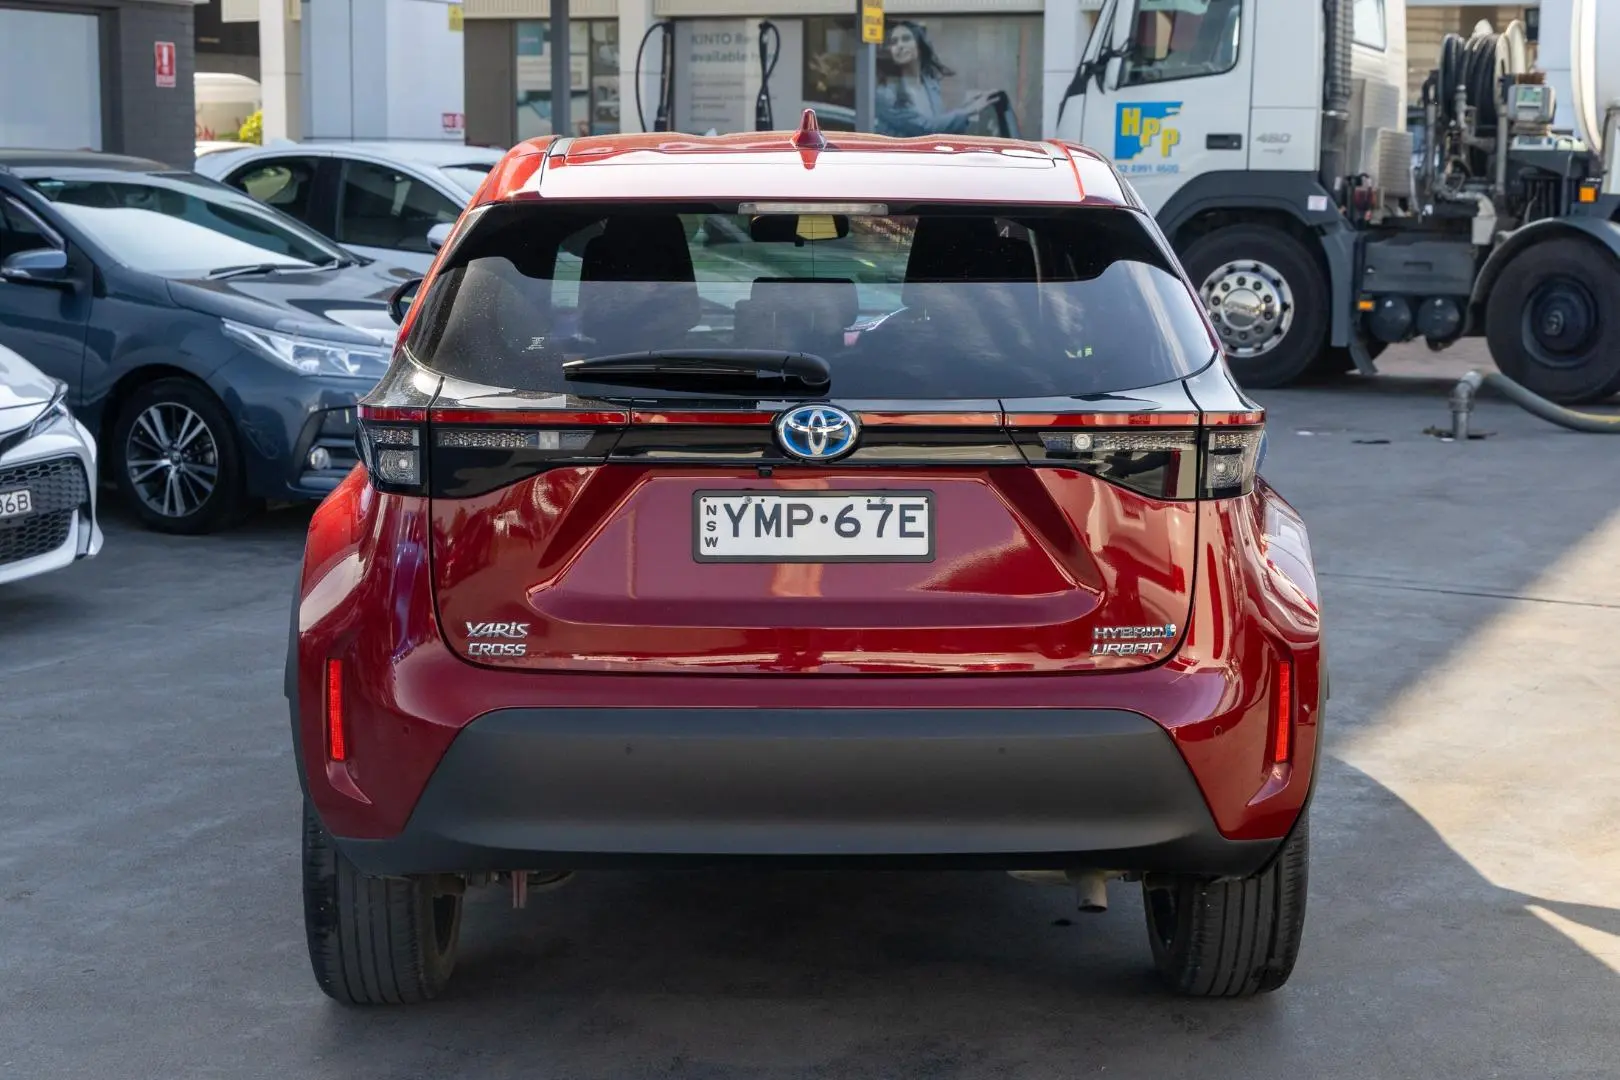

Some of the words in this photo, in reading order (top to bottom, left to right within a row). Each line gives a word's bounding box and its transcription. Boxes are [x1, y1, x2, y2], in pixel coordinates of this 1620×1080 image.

[690, 32, 731, 44] KINTO
[690, 49, 747, 62] available
[1122, 107, 1181, 158] HPP
[0, 494, 28, 513] 6B
[704, 504, 719, 548] NSW
[465, 621, 530, 639] YARIS
[1093, 626, 1164, 639] HYBRID
[467, 642, 527, 656] CROSS
[1092, 642, 1163, 656] URBAN
